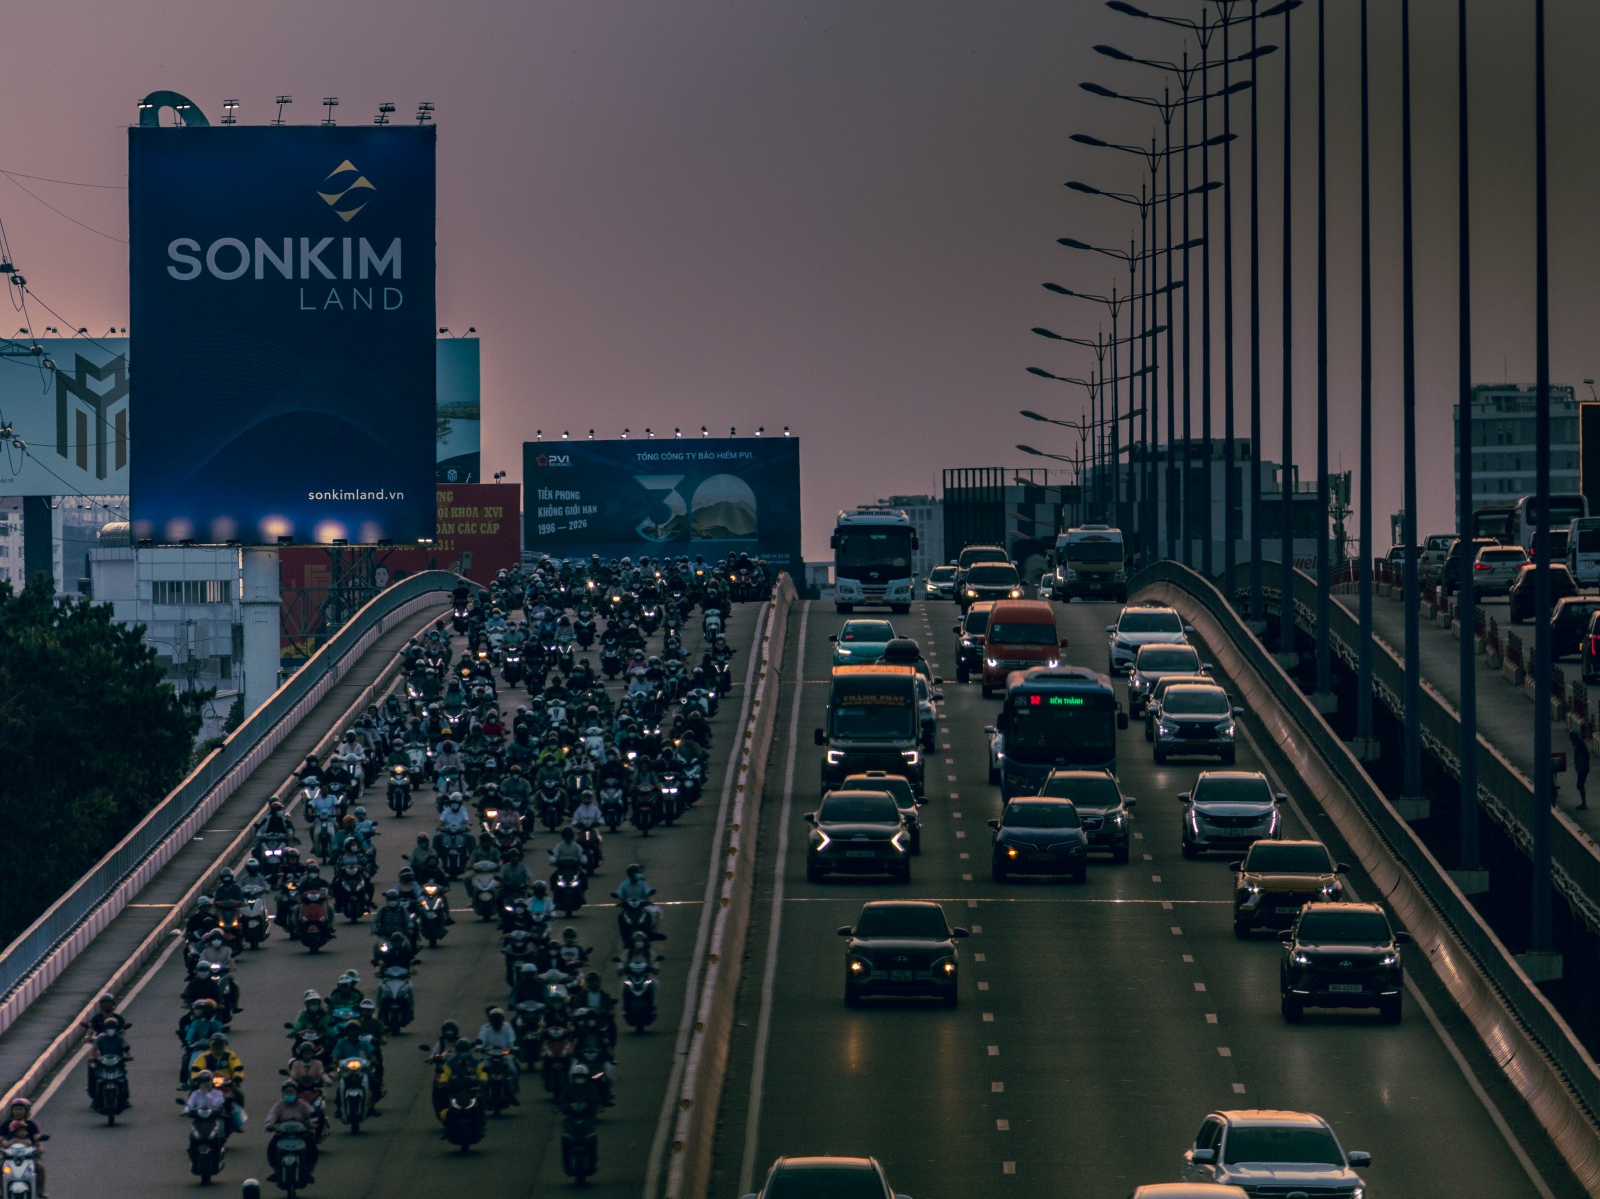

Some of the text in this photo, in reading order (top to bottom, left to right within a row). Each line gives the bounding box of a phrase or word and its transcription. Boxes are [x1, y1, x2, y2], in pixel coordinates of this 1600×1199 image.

[166, 237, 402, 281] SONKIM
[300, 287, 404, 310] LAND
[548, 455, 570, 463] PVI
[660, 451, 684, 460] CÔNG
[685, 452, 697, 460] TY
[738, 451, 752, 459] PVI
[308, 488, 404, 500] sonkimland.vn
[554, 490, 581, 500] PHONG
[451, 504, 479, 518] KHÓA
[483, 506, 503, 518] XVI
[537, 504, 564, 518] KHÔNG
[457, 520, 477, 534] CÁC
[538, 523, 556, 535] 1996
[568, 519, 588, 531] 2026
[1030, 695, 1041, 705] 52
